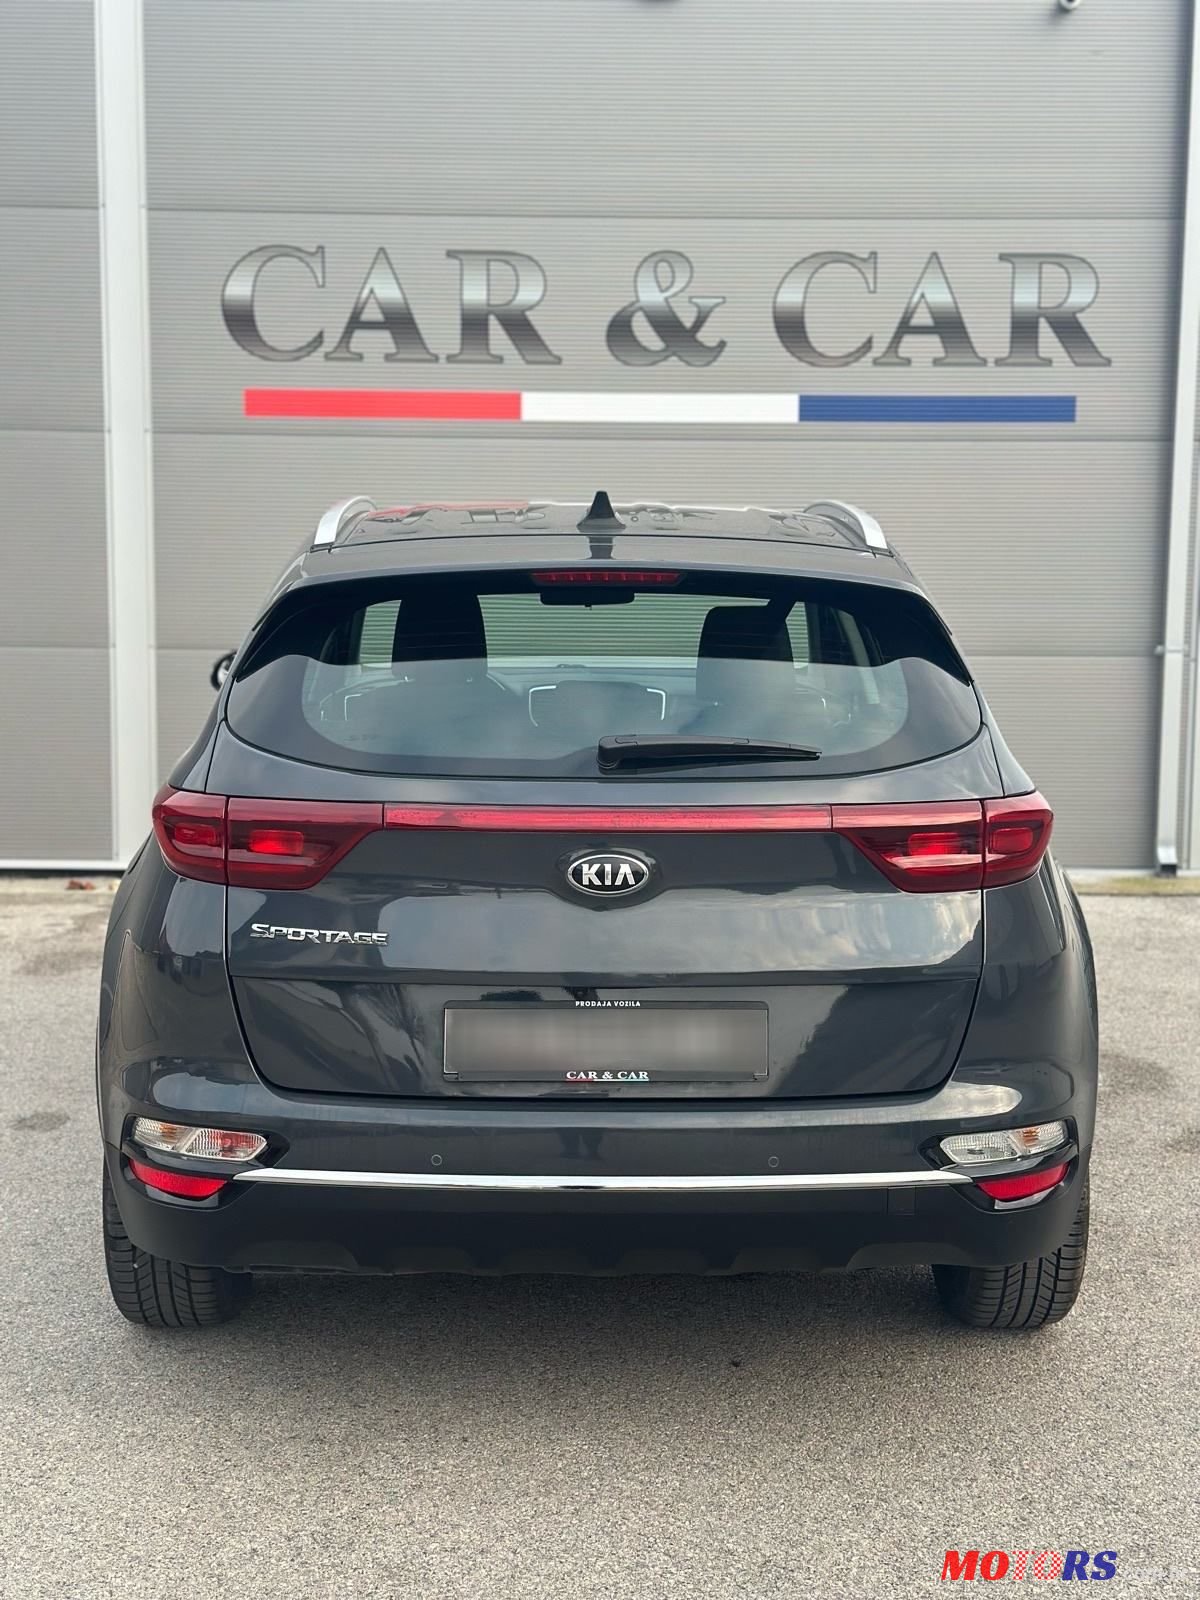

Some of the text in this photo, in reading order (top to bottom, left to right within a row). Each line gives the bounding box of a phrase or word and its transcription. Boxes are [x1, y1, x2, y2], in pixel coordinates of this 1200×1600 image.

[220, 244, 1113, 368] CAR & CAR
[581, 863, 636, 886] KIA
[250, 923, 388, 946] SPORTAGE
[566, 1071, 649, 1080] CAR & CAR
